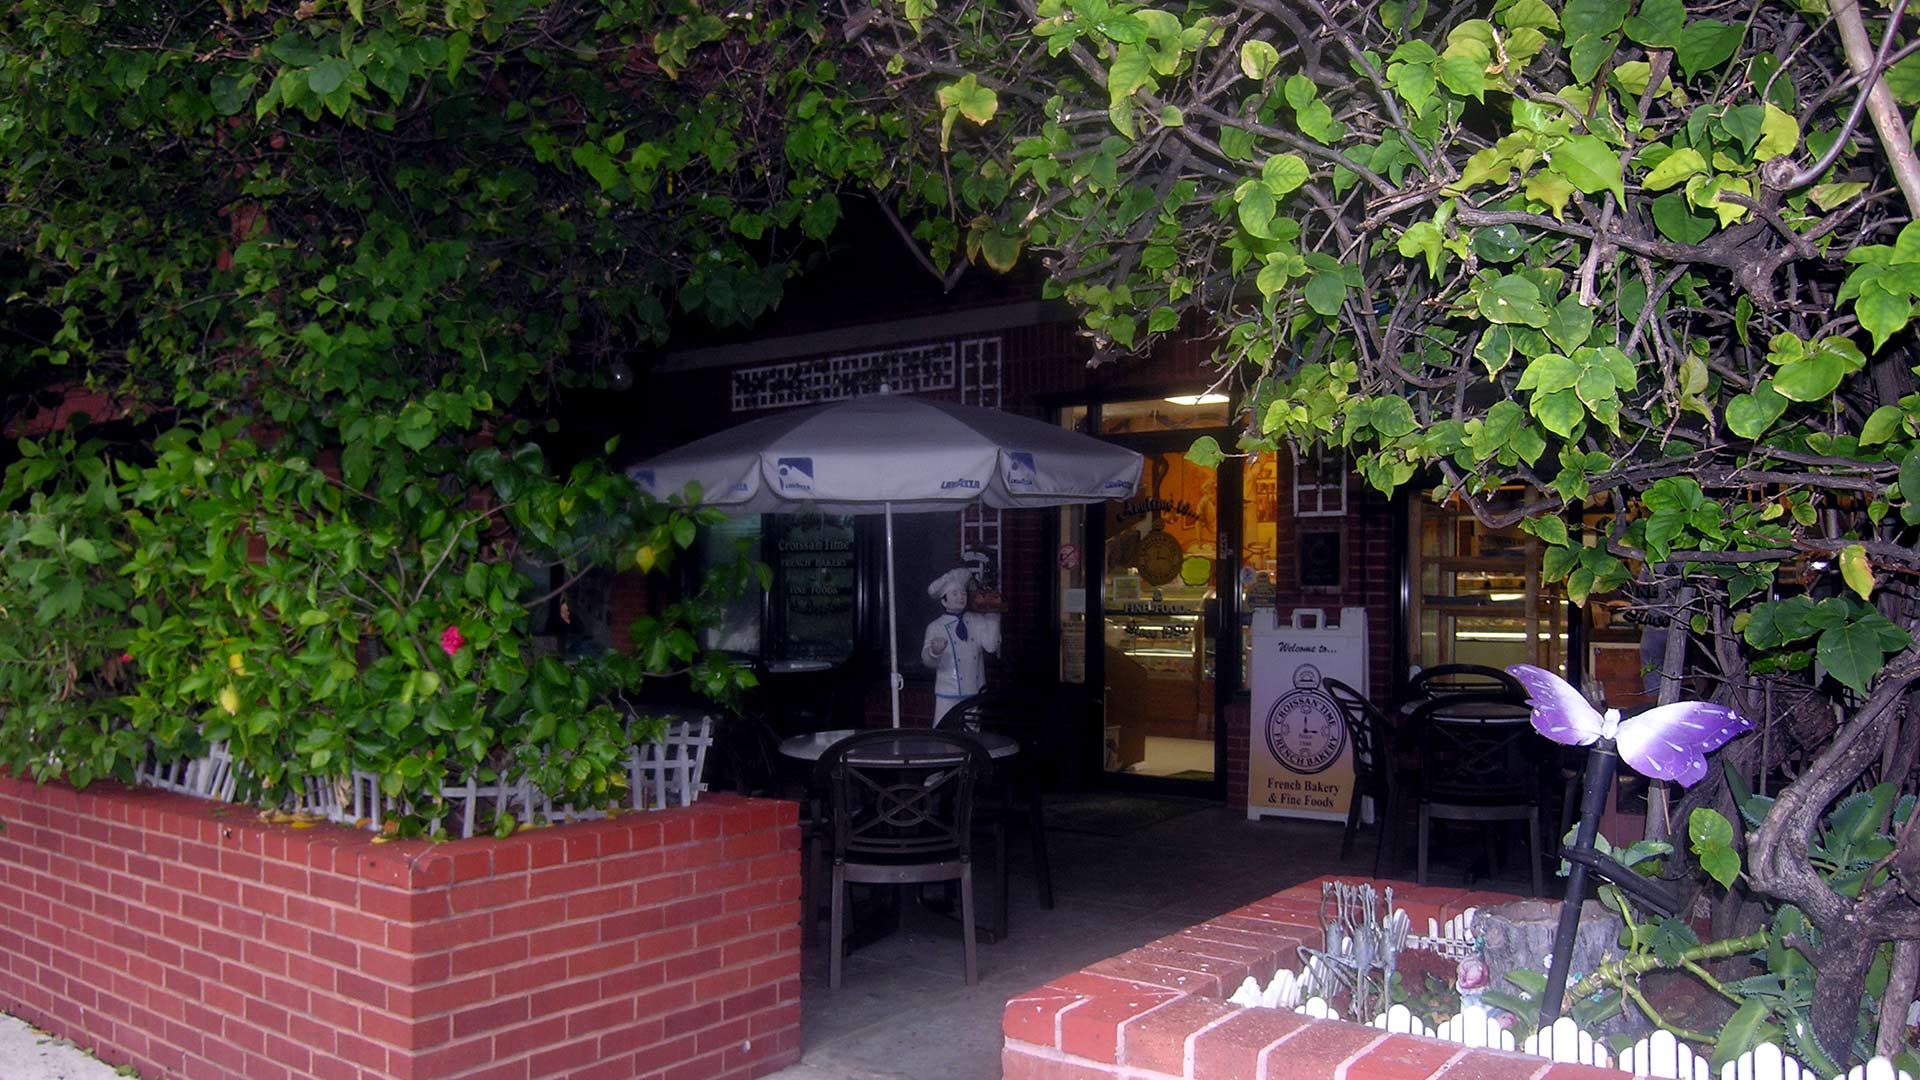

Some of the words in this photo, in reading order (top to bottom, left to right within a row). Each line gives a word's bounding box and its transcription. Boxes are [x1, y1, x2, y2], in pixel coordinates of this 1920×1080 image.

[941, 477, 980, 489] LAVAZZA
[1278, 642, 1316, 653] Welcome
[1318, 645, 1337, 653] to...
[1320, 704, 1336, 726] TIME
[1274, 732, 1304, 766] FRENCH
[1306, 736, 1338, 766] BAKERY
[1267, 777, 1301, 791] French
[1304, 780, 1339, 796] Bakery
[1268, 792, 1277, 804] &
[1280, 793, 1301, 806] Fine
[1304, 794, 1334, 808] Foods
